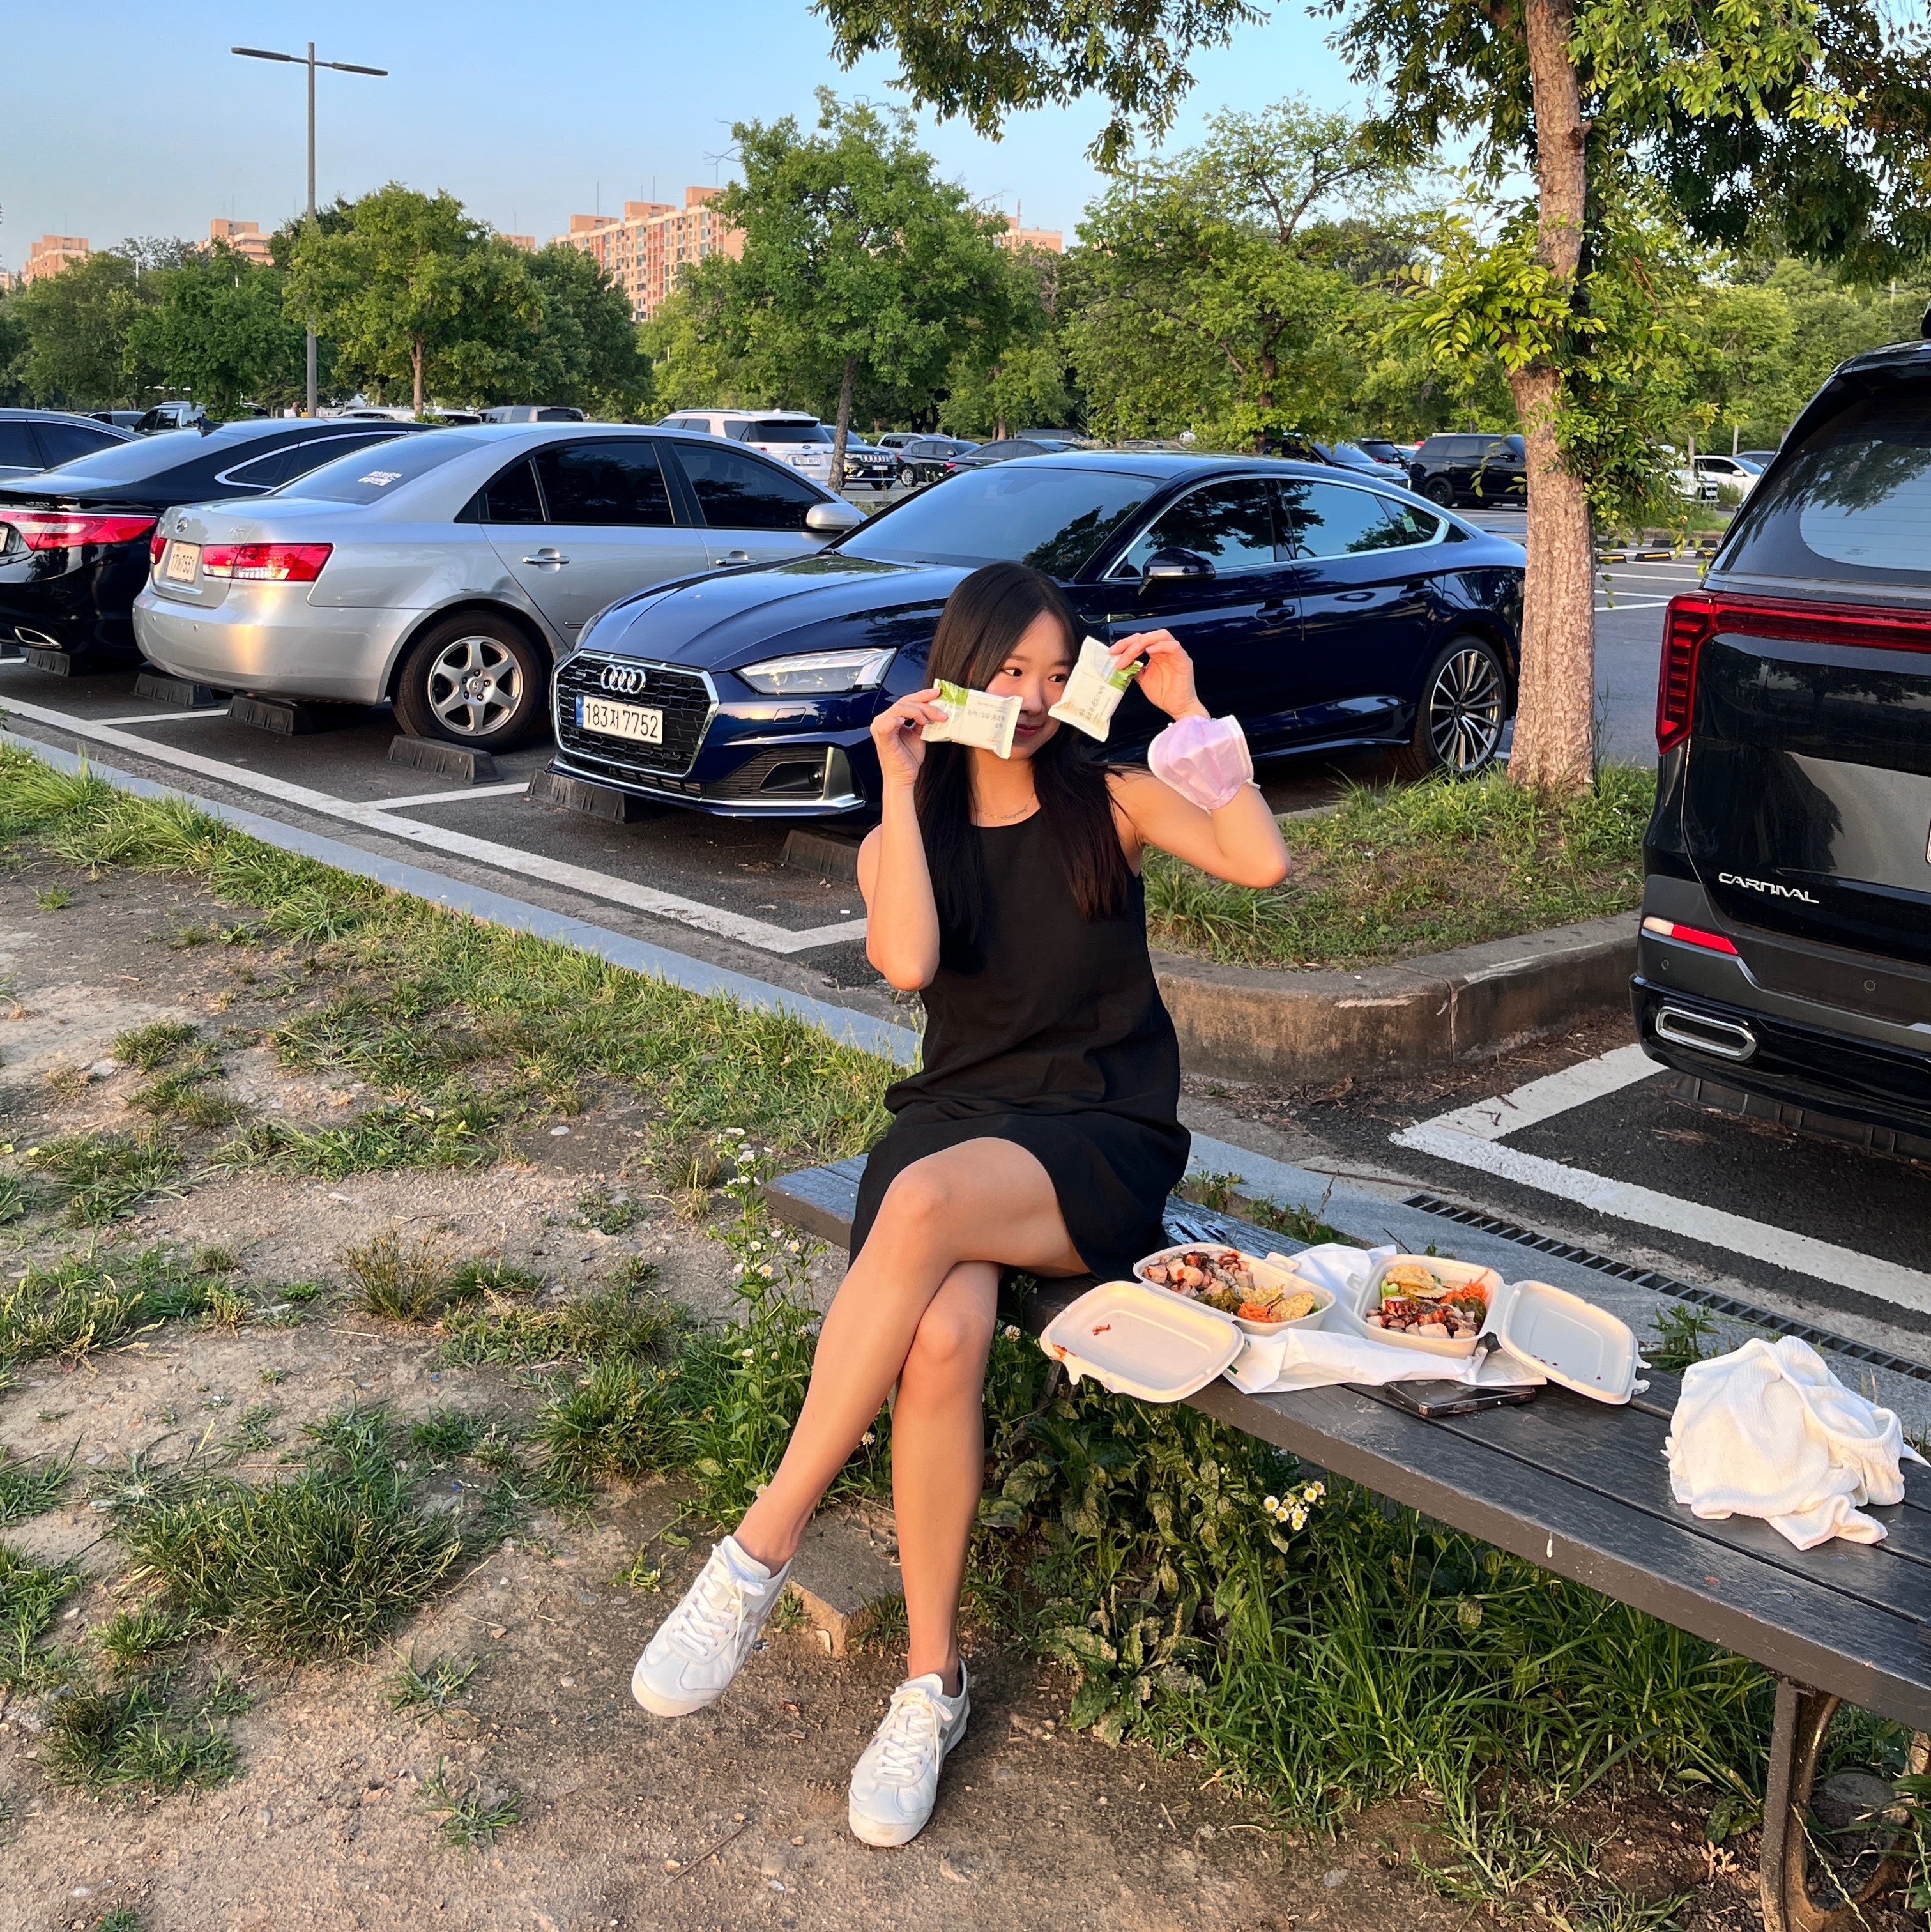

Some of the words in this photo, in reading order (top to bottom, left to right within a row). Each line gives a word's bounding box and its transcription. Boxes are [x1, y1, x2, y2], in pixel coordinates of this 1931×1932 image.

[586, 703, 619, 730] 183저
[623, 710, 658, 738] 7752
[1718, 872, 1819, 903] CARNIVAL
